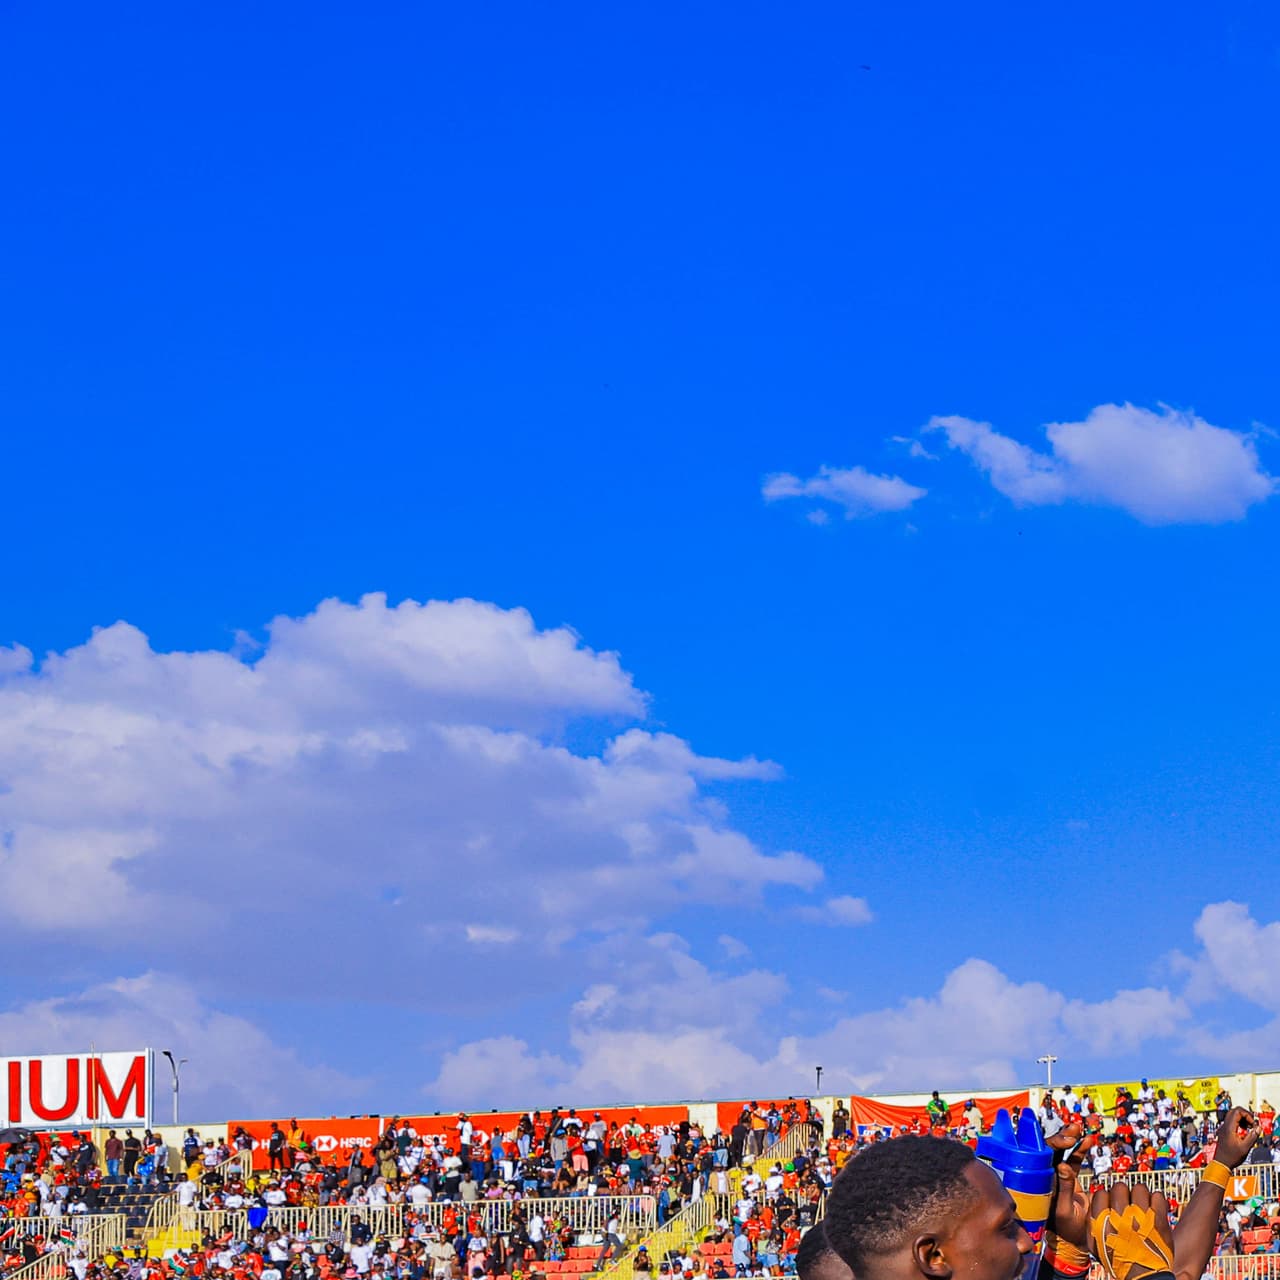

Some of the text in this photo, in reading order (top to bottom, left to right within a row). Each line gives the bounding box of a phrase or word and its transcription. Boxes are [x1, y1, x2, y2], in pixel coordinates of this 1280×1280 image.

[8, 1056, 146, 1123] IUM
[340, 1136, 372, 1149] HSBC
[1233, 1178, 1248, 1198] K
